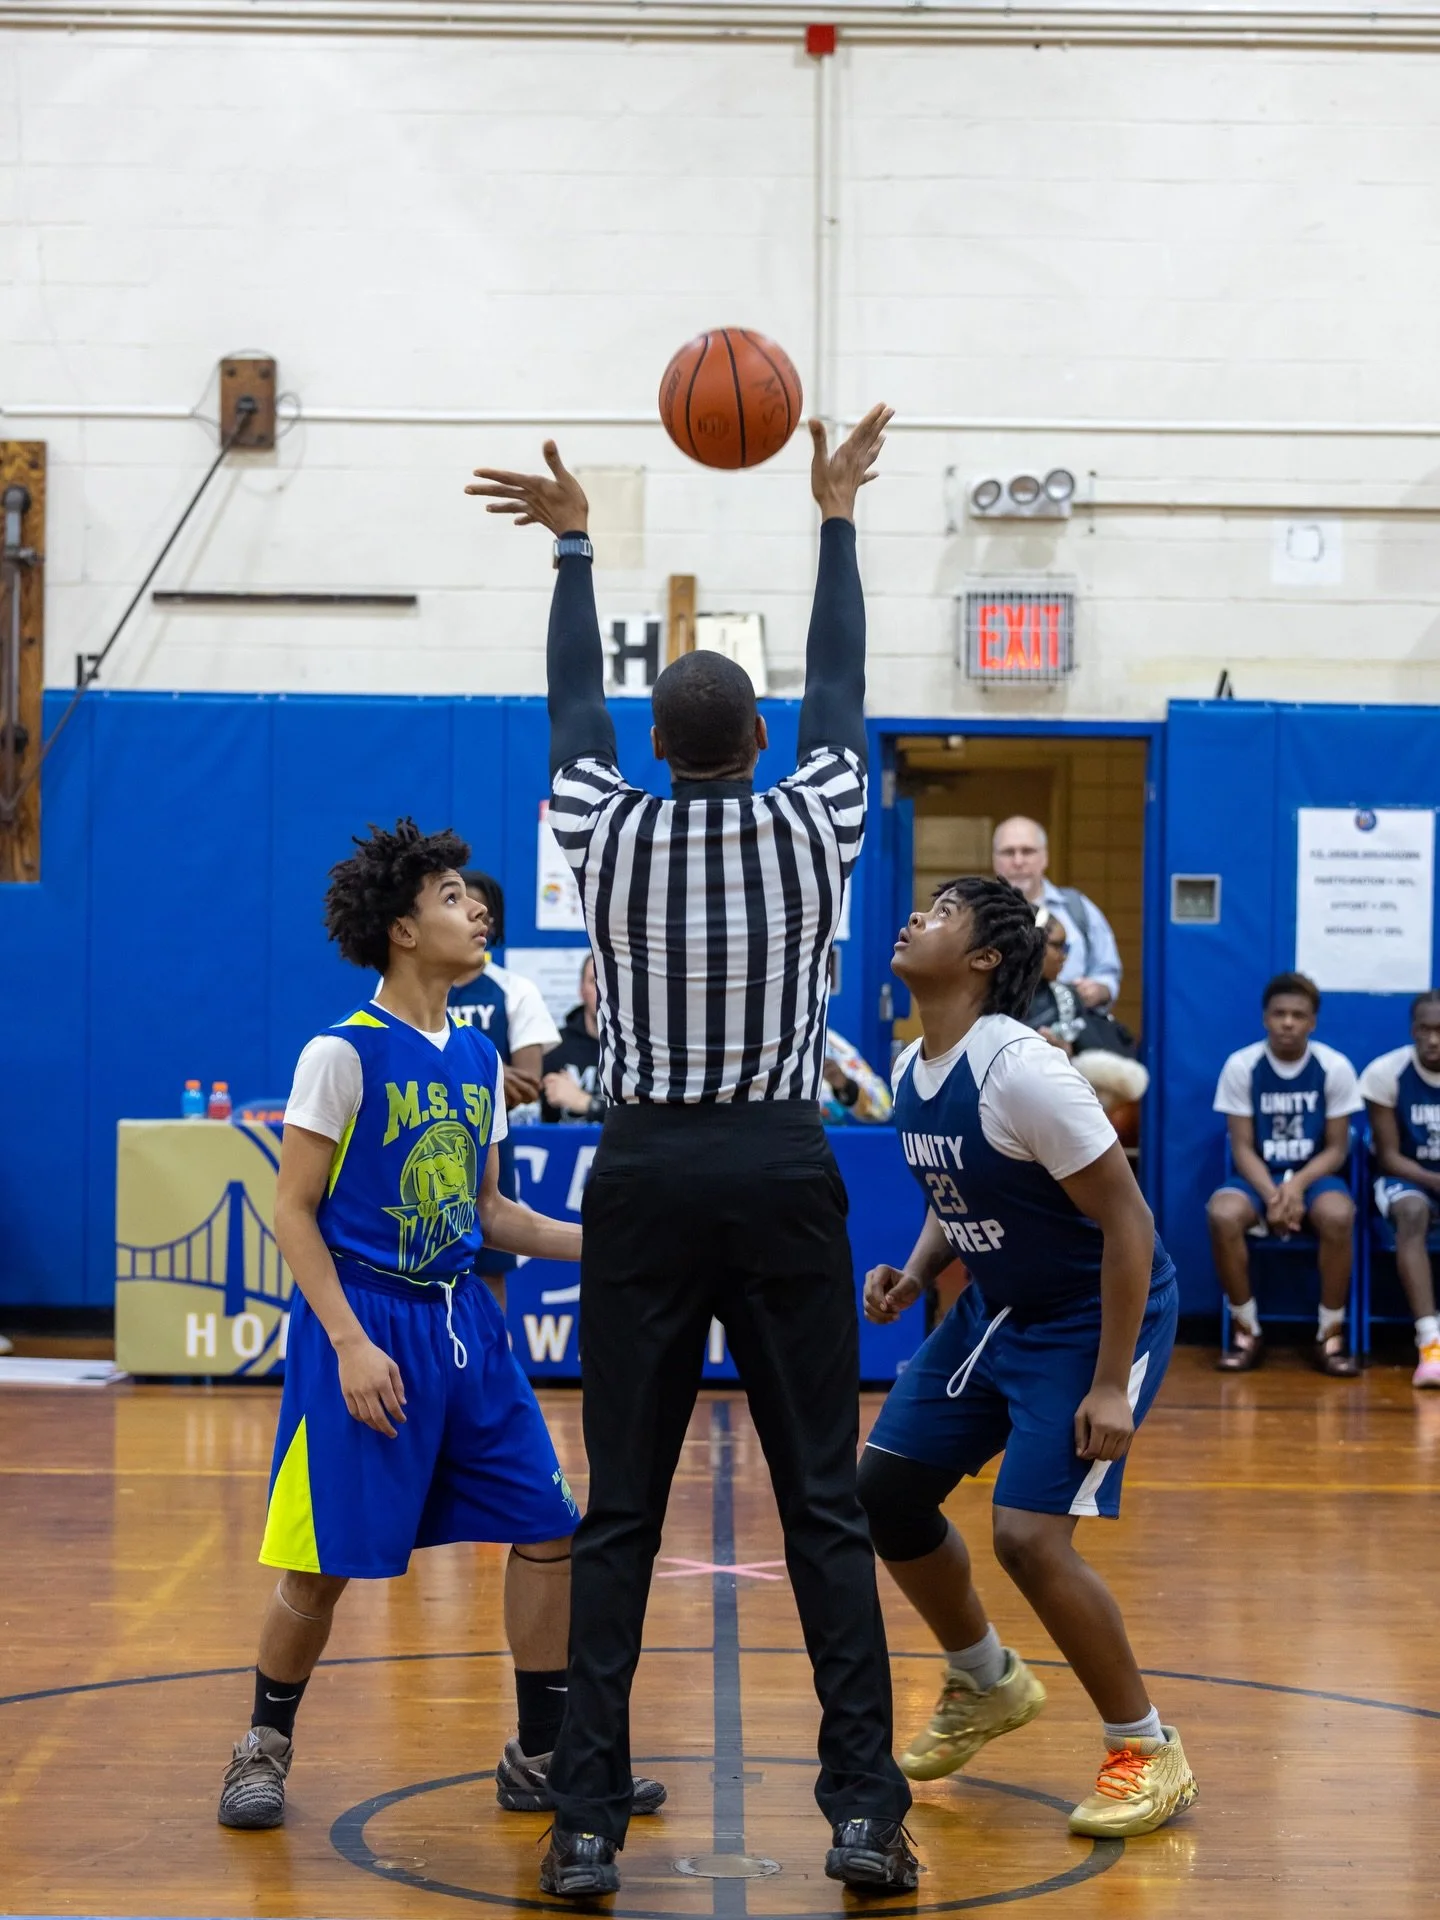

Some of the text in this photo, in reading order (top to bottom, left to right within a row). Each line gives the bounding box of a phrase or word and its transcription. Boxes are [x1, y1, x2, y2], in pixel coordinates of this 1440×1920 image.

[978, 603, 1064, 671] EXIT
[383, 1081, 492, 1147] M.S. 50
[1260, 1090, 1319, 1114] UNITY
[1272, 1114, 1305, 1140] 24
[902, 1131, 964, 1170] UNITY
[1263, 1138, 1315, 1162] PREP
[925, 1172, 969, 1215] 23
[937, 1218, 1005, 1253] PREP
